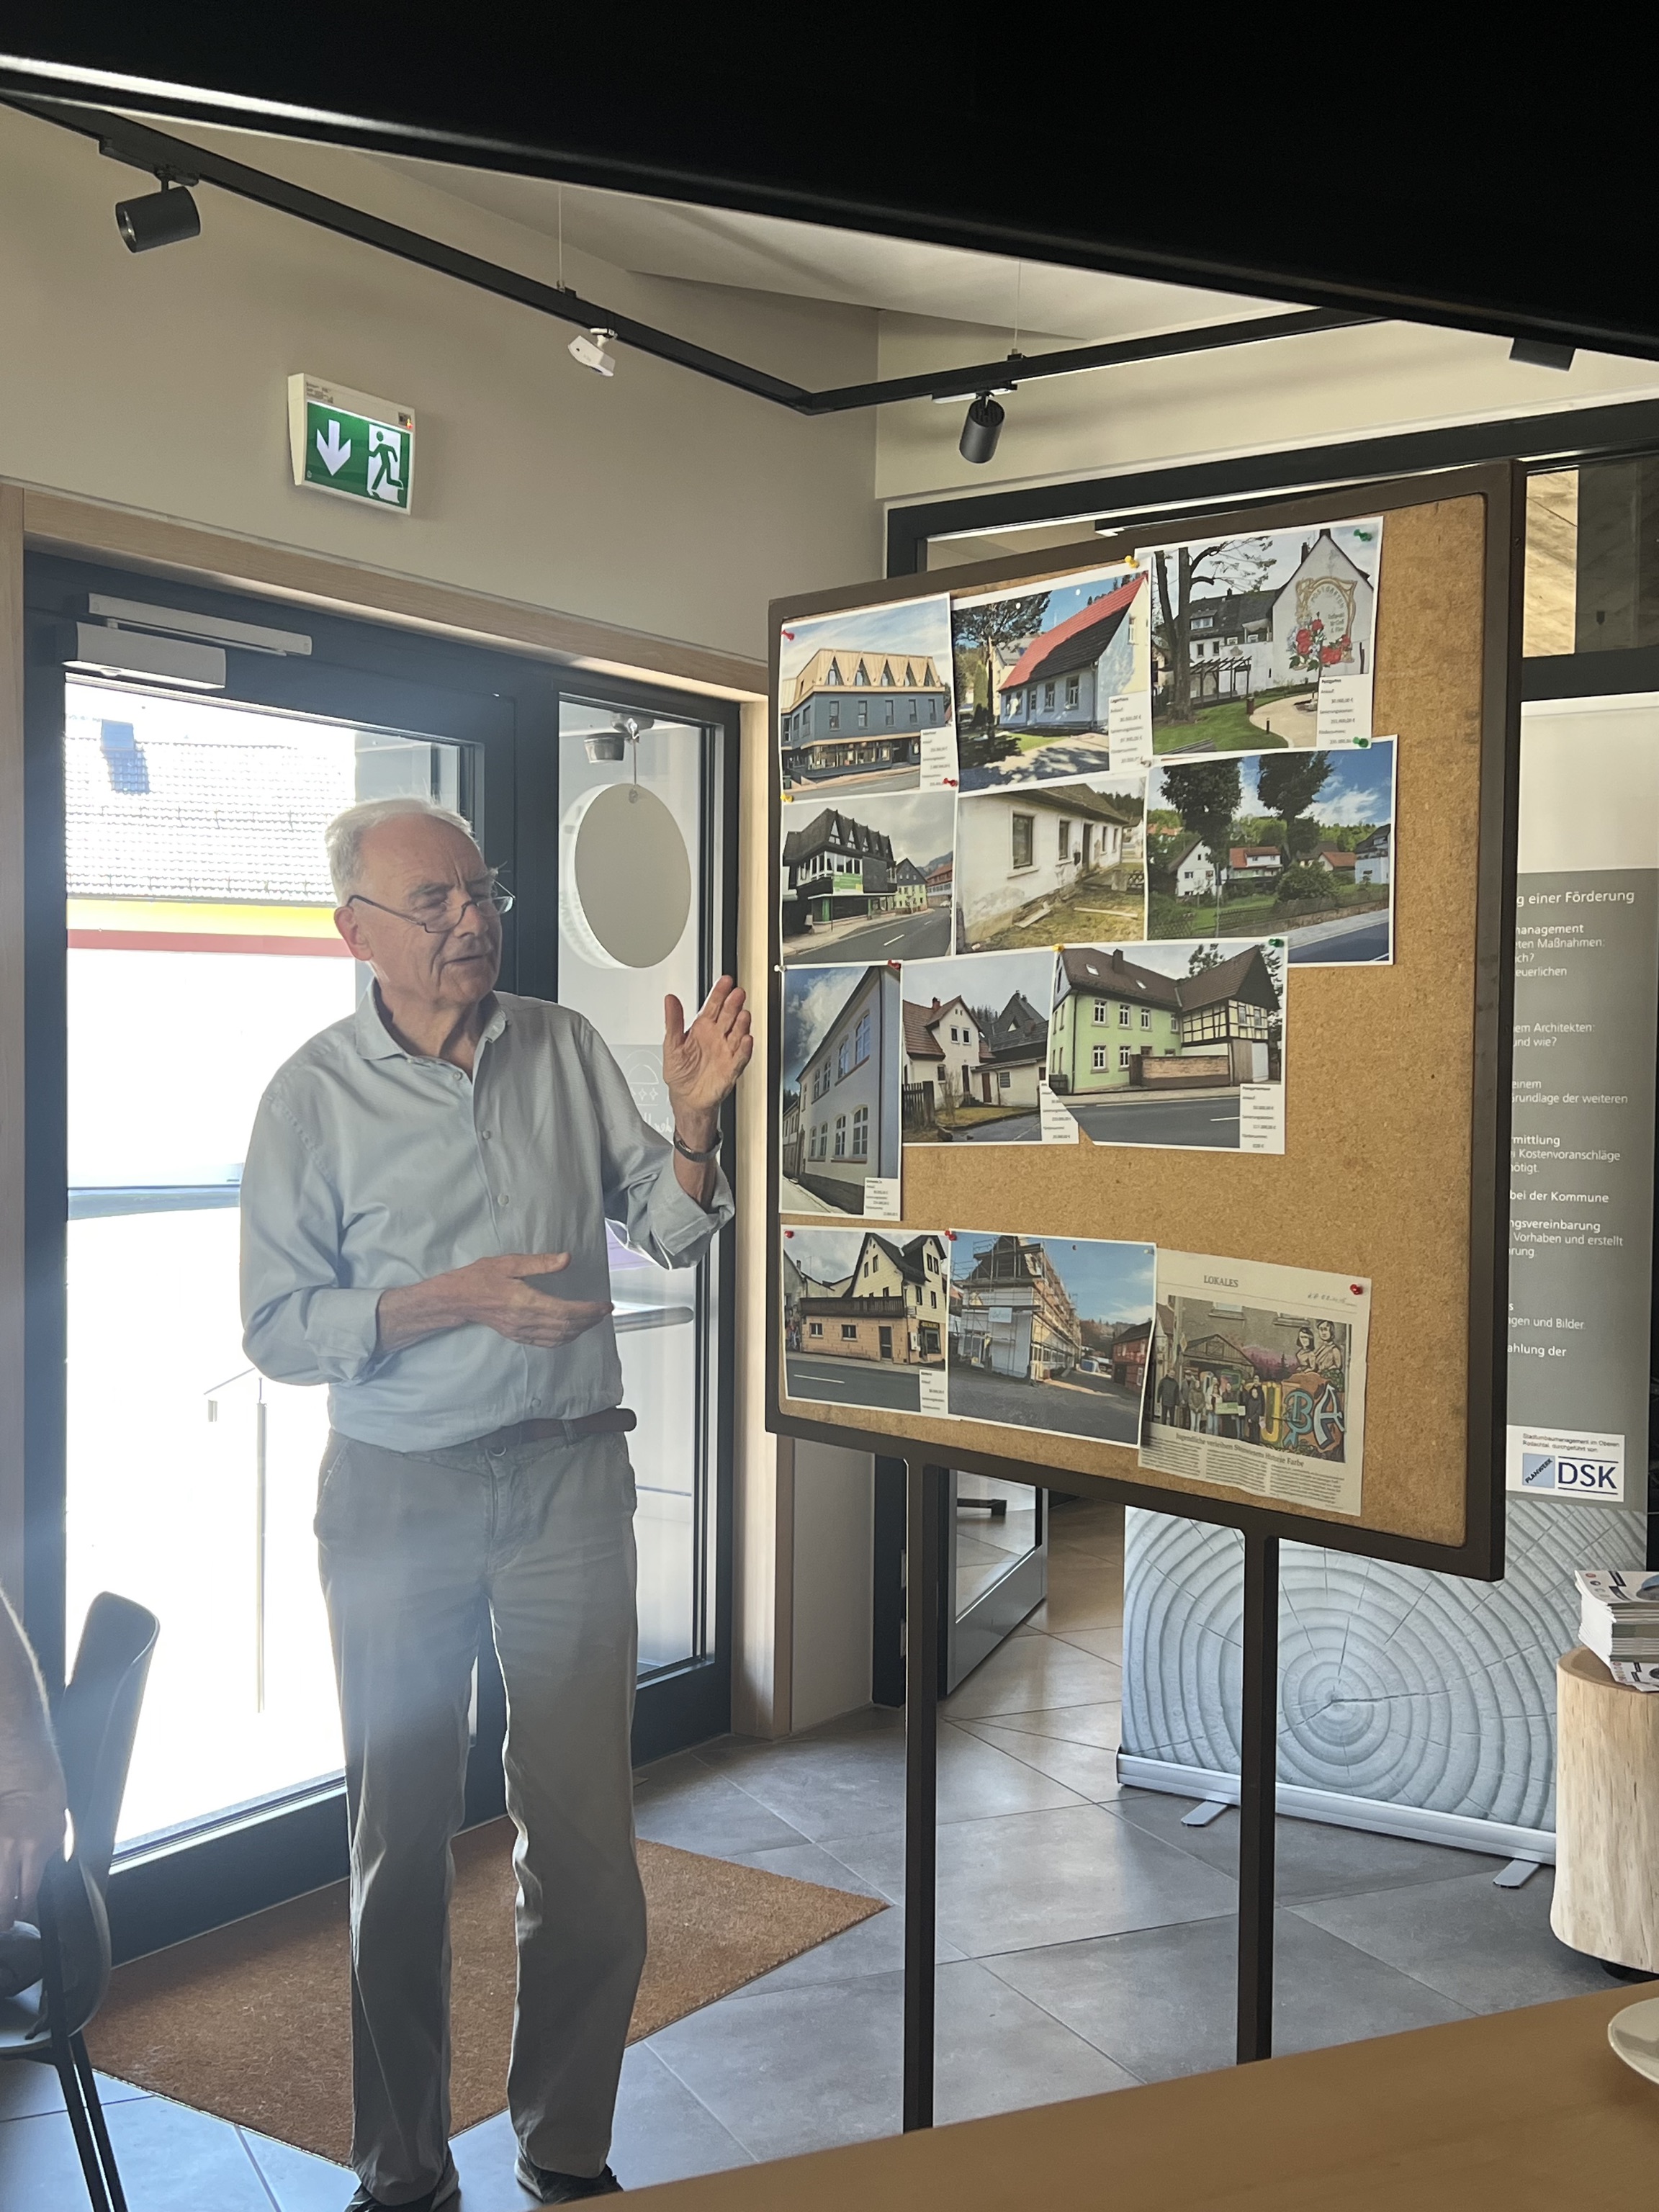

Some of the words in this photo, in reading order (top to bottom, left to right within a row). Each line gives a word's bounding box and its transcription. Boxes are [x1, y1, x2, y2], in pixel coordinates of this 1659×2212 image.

[1529, 893, 1562, 904] einer
[1565, 890, 1635, 904] Förderung
[1537, 938, 1605, 948] Maßnahmen:
[1515, 966, 1568, 977] euerlichen
[1514, 1025, 1531, 1033] em
[1534, 1022, 1594, 1033] Architekten:
[1533, 1037, 1557, 1047] wie?
[1512, 1081, 1542, 1089] einem
[1563, 1093, 1579, 1104] der
[1583, 1094, 1628, 1105] weiteren
[1519, 1148, 1621, 1163] Kostenvoranschläge
[1510, 1190, 1526, 1200] bei
[1529, 1190, 1548, 1201] der
[1551, 1192, 1610, 1203] Kommune
[1513, 1232, 1562, 1244] Vorhaben
[1565, 1234, 1585, 1245] und
[1588, 1235, 1624, 1246] erstellt
[1203, 1274, 1239, 1288] LOKALES
[1533, 1317, 1553, 1328] und
[1507, 1342, 1545, 1357] ahlung
[1547, 1345, 1567, 1357] der
[1558, 1462, 1617, 1490] DSK
